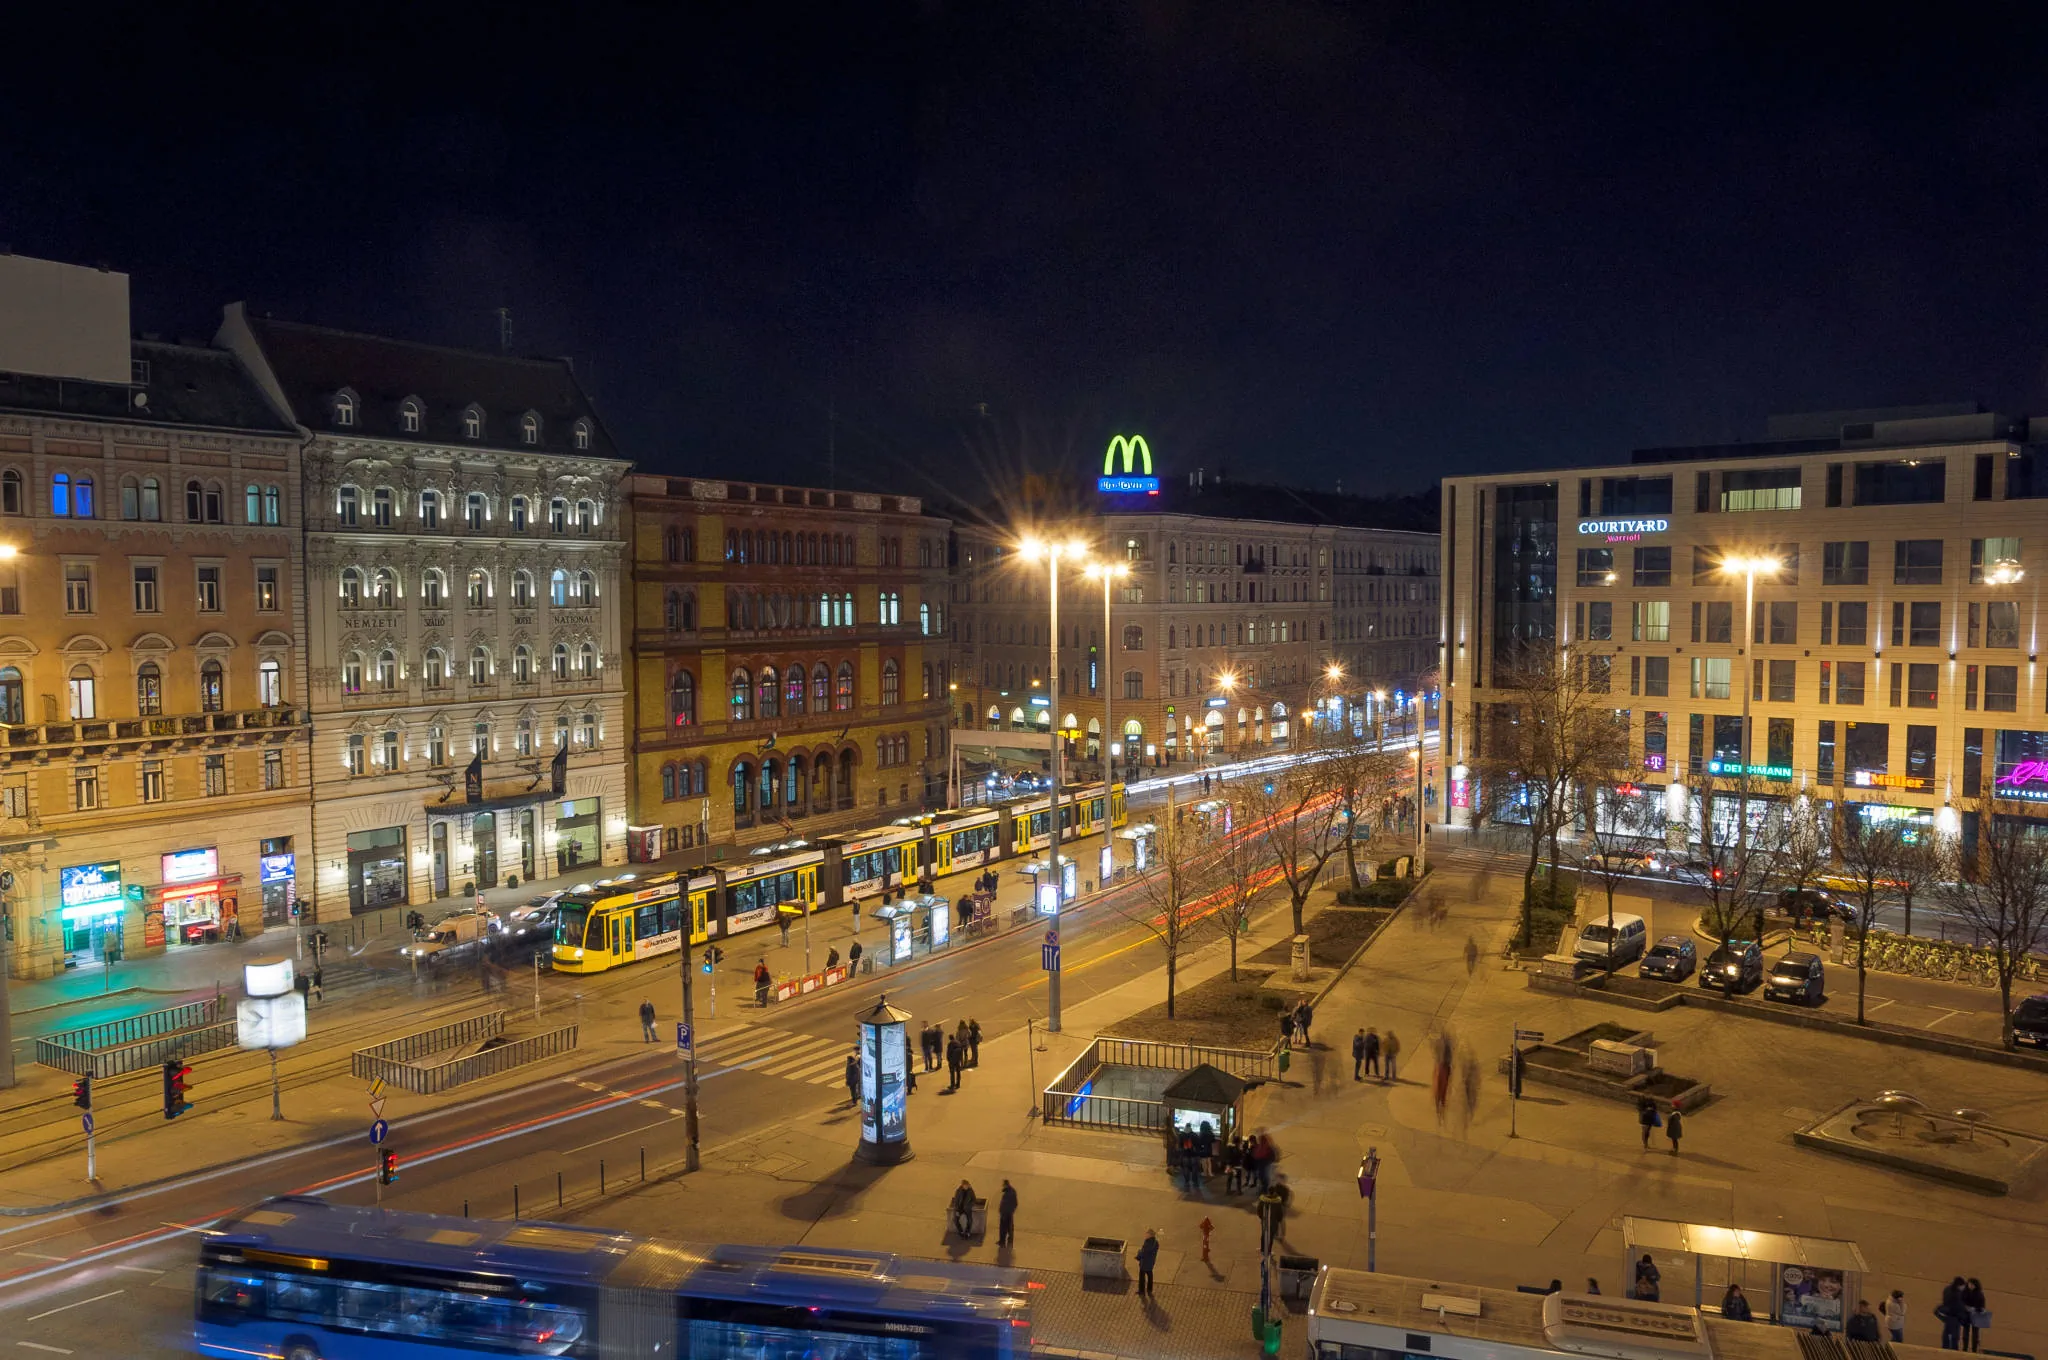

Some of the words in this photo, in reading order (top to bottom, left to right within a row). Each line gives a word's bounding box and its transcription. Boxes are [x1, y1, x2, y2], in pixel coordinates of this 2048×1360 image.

[1578, 519, 1668, 534] COURTYARD
[1605, 533, 1641, 543] Marriott
[345, 618, 397, 628] NEMZETI
[554, 615, 593, 624] NATIONAL
[1870, 774, 1925, 788] Müller
